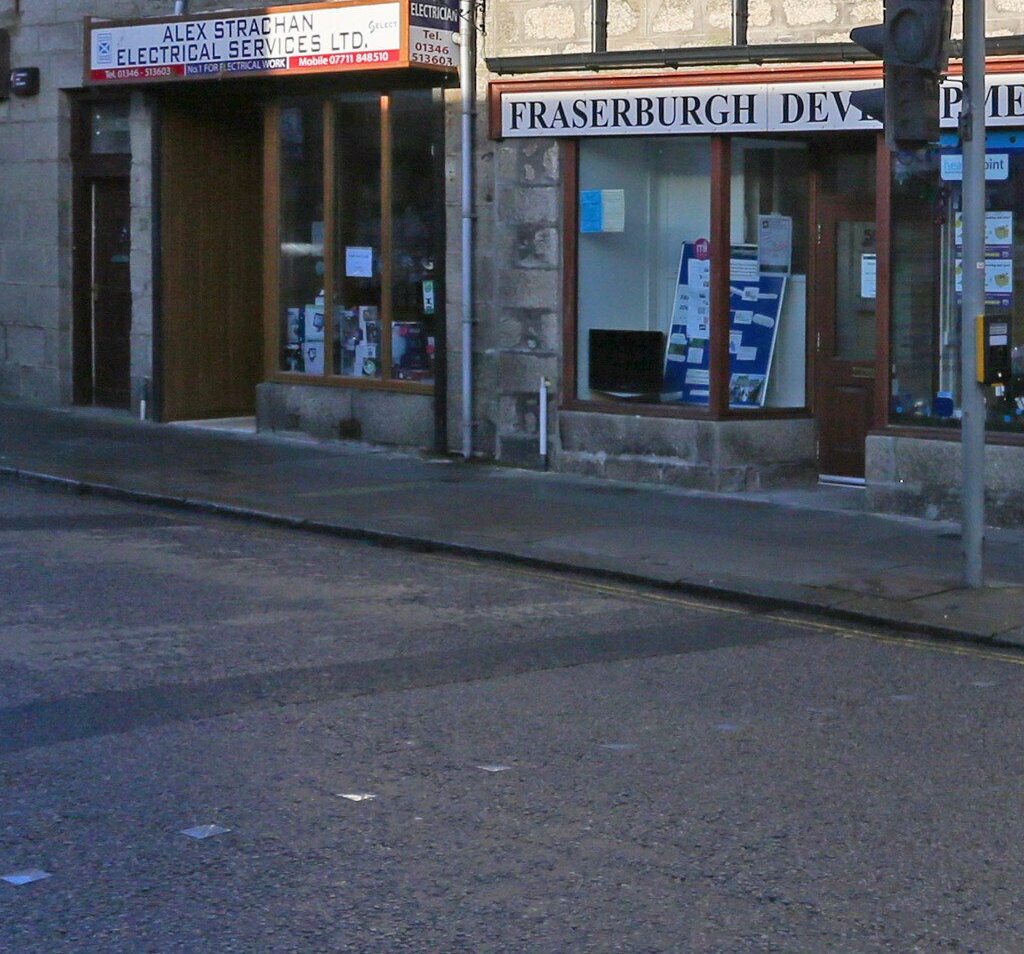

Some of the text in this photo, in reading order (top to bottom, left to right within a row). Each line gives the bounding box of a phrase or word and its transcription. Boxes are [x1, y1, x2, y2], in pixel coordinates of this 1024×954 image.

[410, 2, 458, 23] ELECTRICIAN
[162, 13, 314, 43] ALEX STRACHAN
[422, 29, 442, 42] Tel.
[117, 31, 368, 66] ELECTRICAL SERVICES LTD.
[415, 42, 449, 55] 01346
[203, 63, 219, 73] FOR
[219, 61, 261, 72] ELECTRICAL
[262, 57, 286, 69] WORK
[298, 56, 329, 67] Mobile
[329, 54, 354, 65] 07711
[411, 53, 453, 67] 513603
[105, 70, 117, 79] Tel.
[117, 68, 139, 78] 01346
[144, 66, 171, 77] 513603
[509, 93, 757, 131] FRASERBURGH
